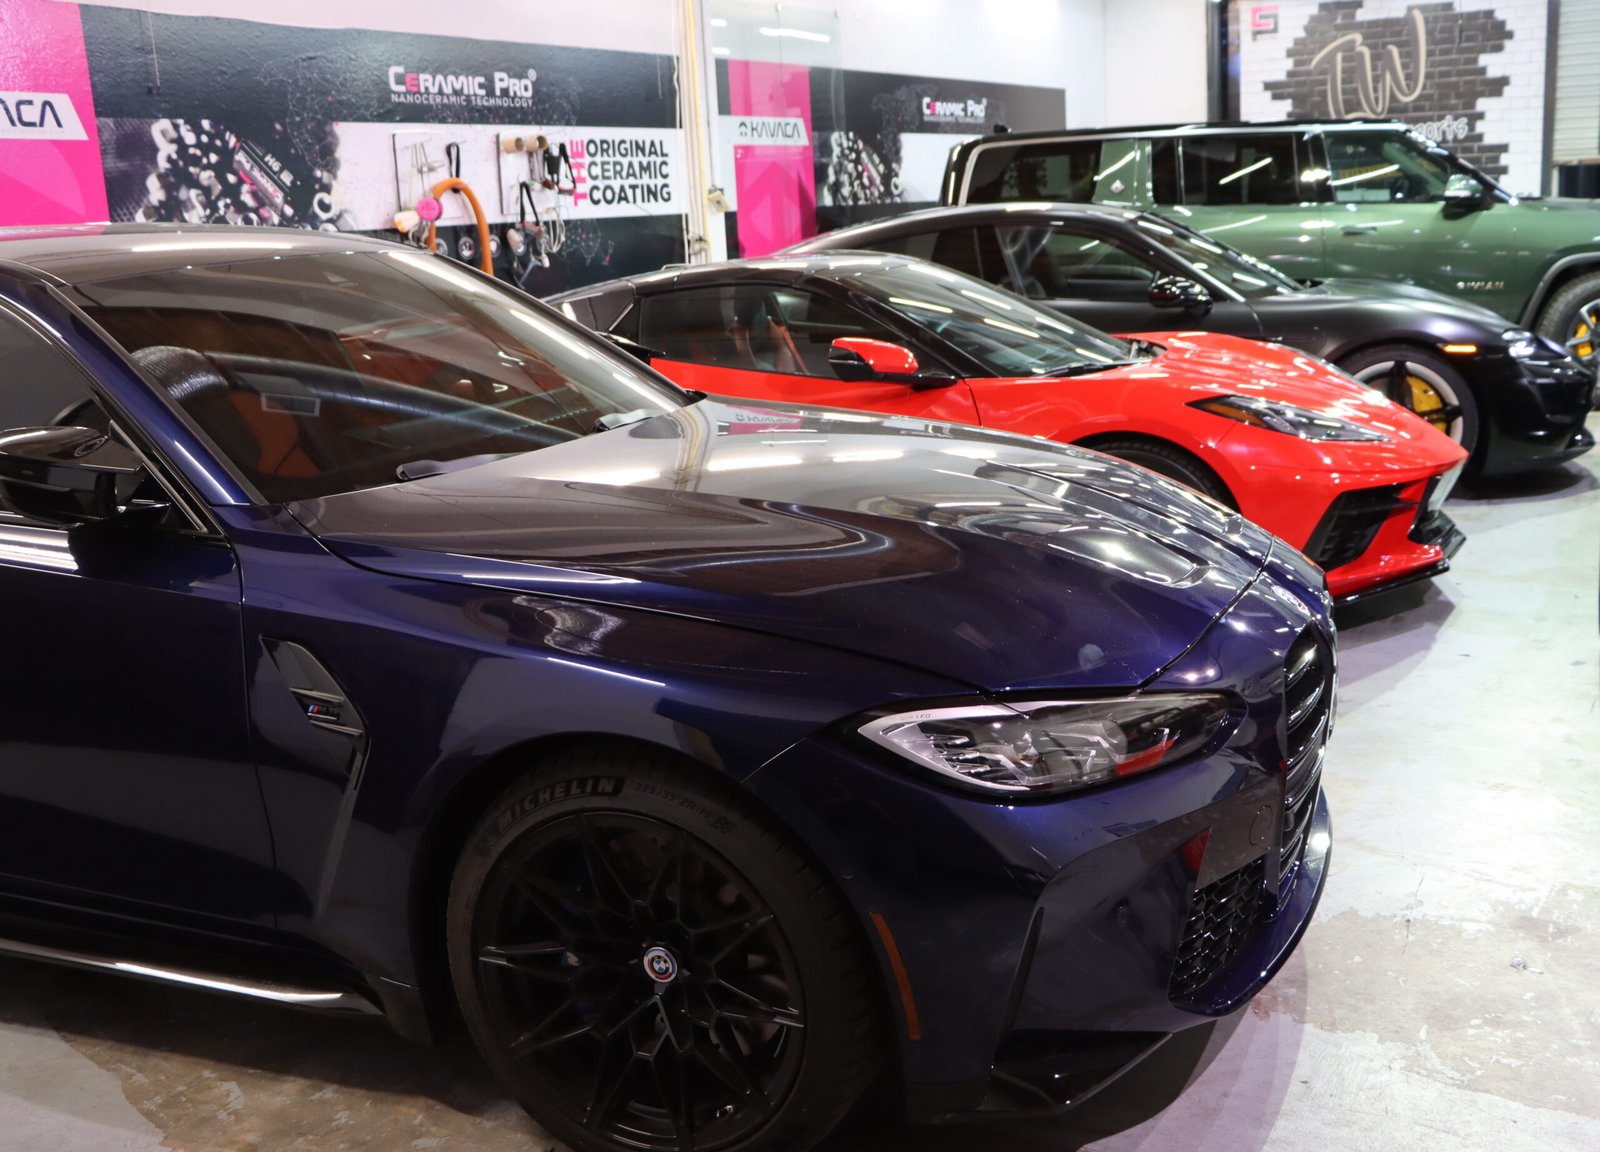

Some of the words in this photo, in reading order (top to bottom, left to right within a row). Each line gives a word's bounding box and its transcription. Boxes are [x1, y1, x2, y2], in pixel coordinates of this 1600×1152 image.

[388, 66, 486, 96] CERAMIC
[391, 93, 467, 105] NANOCERAMIC
[471, 95, 533, 108] TECHNOLOGY
[751, 121, 801, 138] KAVACA
[585, 138, 669, 158] ORIGINAL
[570, 139, 588, 207] THE
[587, 160, 670, 180] CERAMIC
[589, 183, 672, 206] COATING
[496, 776, 618, 833] MICHELIN
